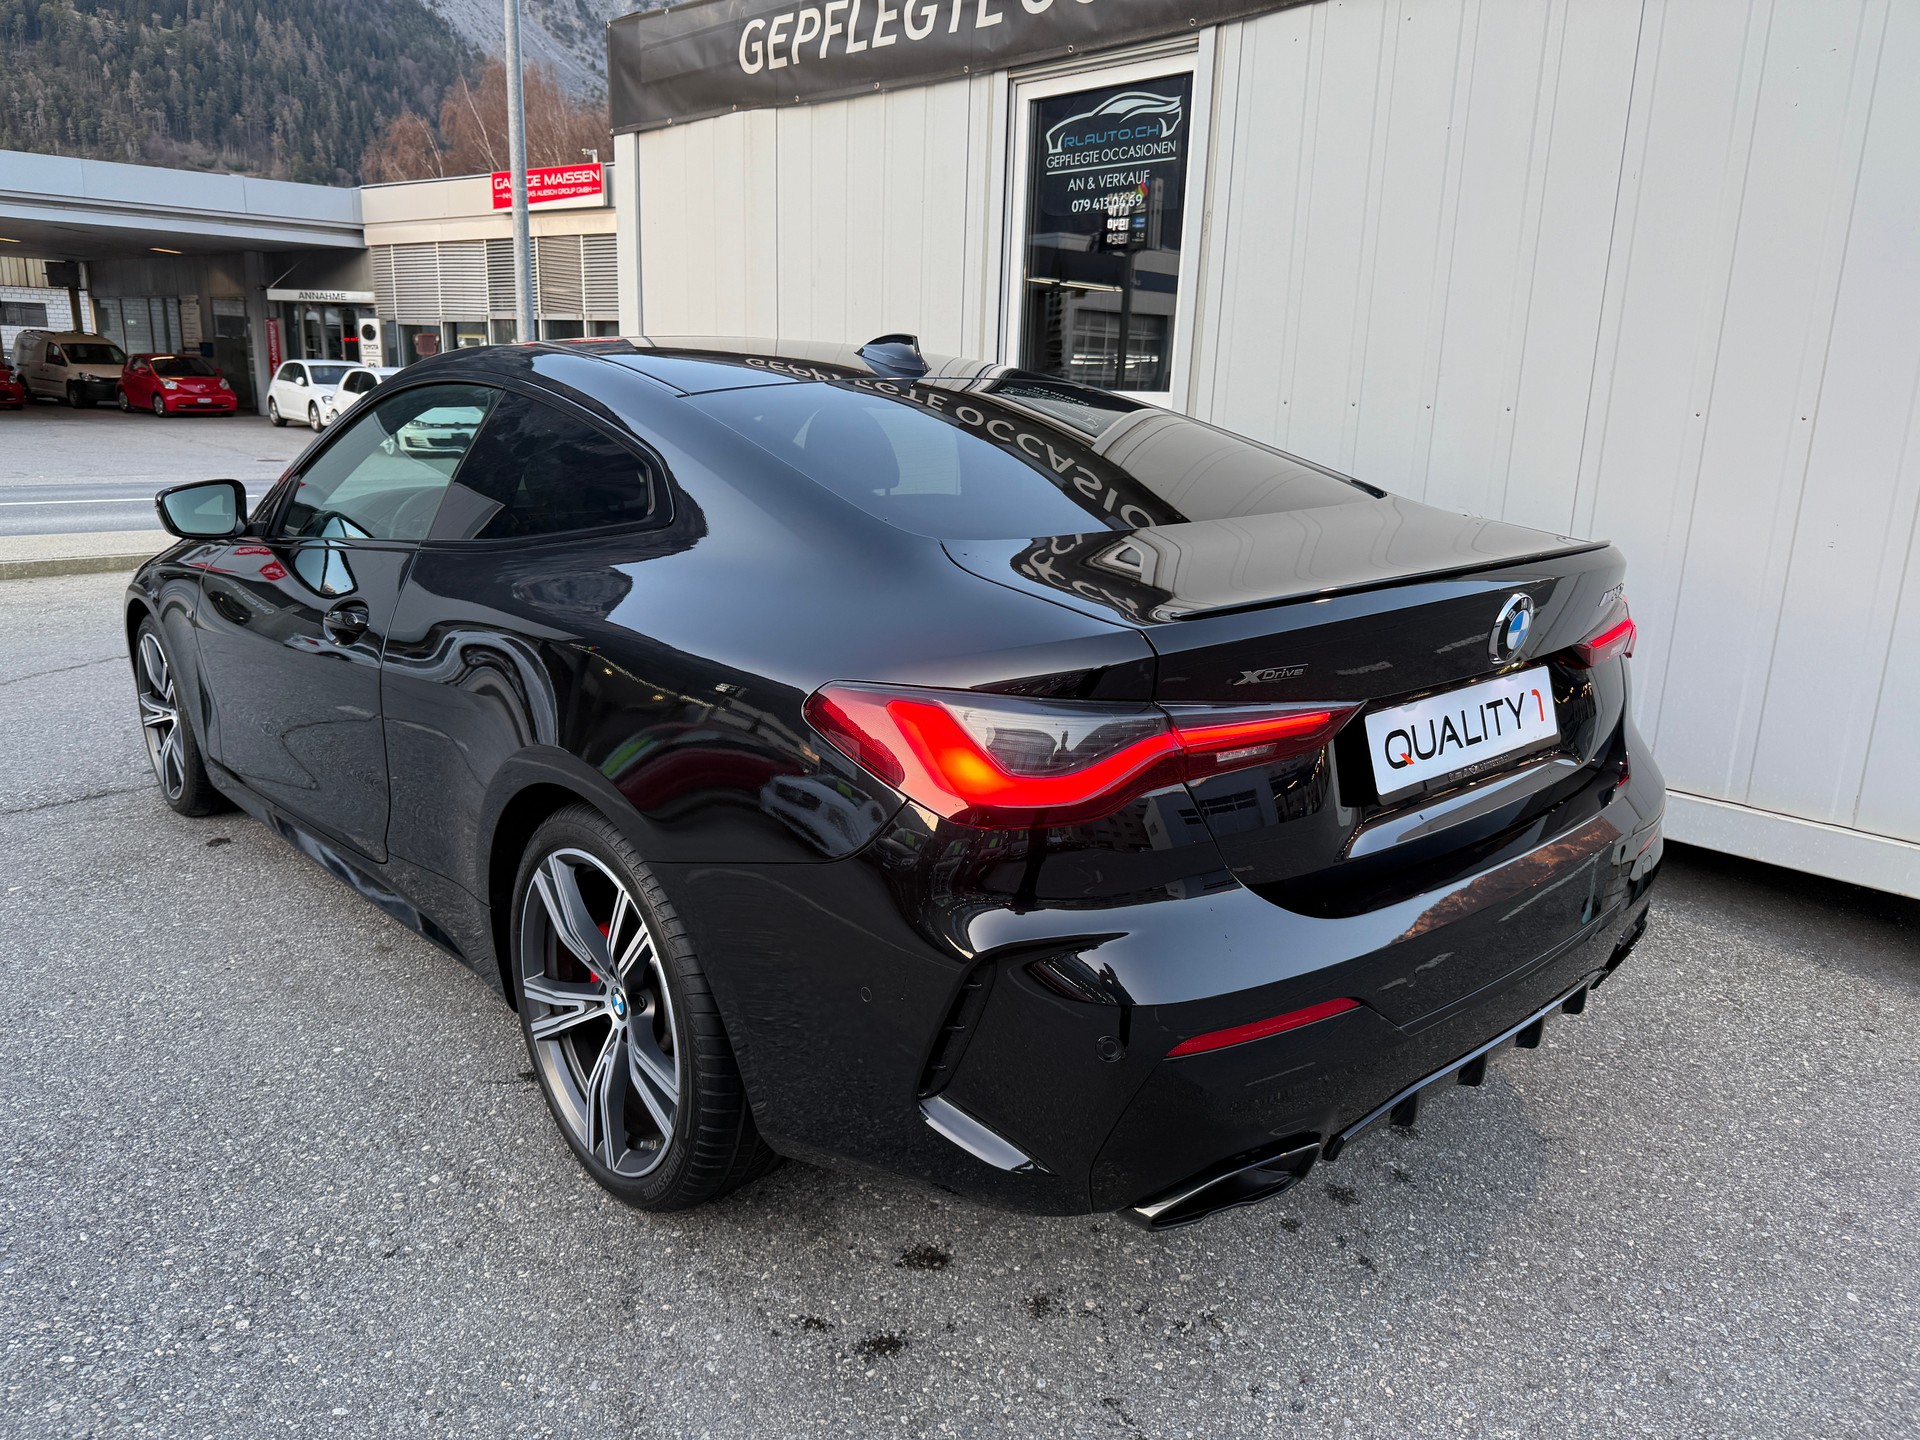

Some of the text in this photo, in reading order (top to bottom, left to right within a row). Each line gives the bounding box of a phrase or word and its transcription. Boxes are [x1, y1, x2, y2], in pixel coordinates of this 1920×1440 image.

[1064, 124, 1159, 148] RLAUTO.CH
[1046, 140, 1177, 169] GEPFLEGTE OCCASIONEN
[494, 169, 600, 190] GAGE MAISSEN
[1067, 170, 1151, 192] AN & VERKAUF
[1071, 200, 1091, 213] 079
[1092, 197, 1109, 210] 413
[1128, 193, 1143, 207] 69
[298, 291, 347, 301] ANNAHME
